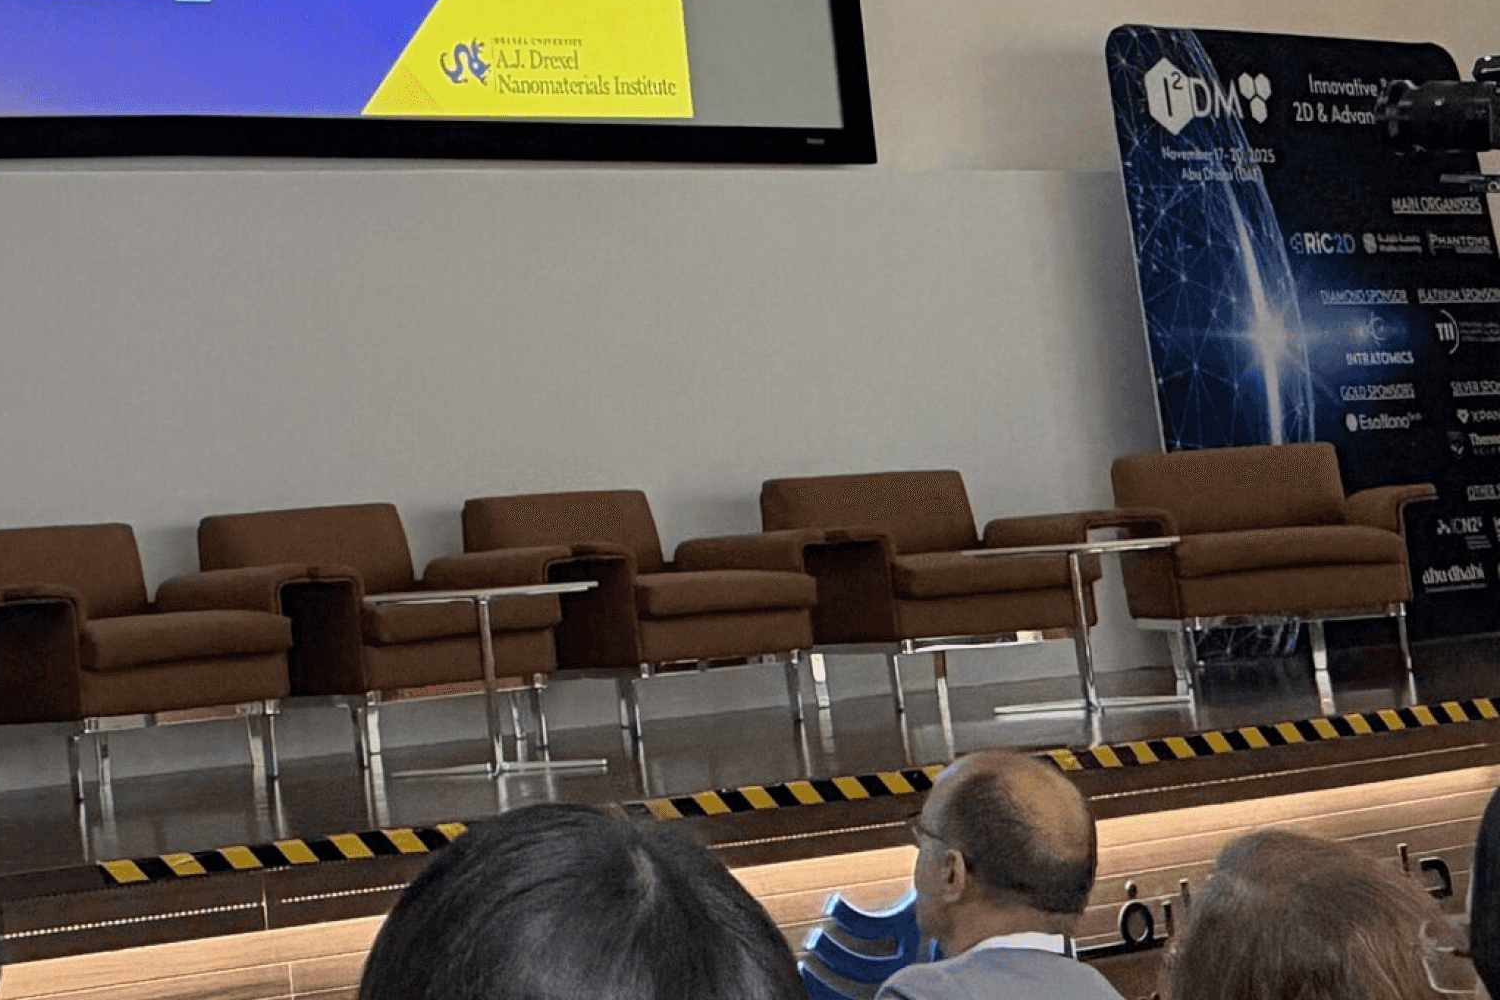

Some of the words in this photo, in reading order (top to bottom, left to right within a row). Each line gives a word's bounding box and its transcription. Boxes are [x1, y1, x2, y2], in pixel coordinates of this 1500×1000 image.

[496, 49, 525, 69] A.J.
[530, 49, 579, 70] Drexel
[498, 74, 610, 96] Nanomaterials
[614, 75, 676, 96] Institute
[1308, 72, 1378, 97] Innovative
[1293, 102, 1314, 122] 2D
[1317, 102, 1328, 122] &
[1331, 104, 1376, 124] Advan
